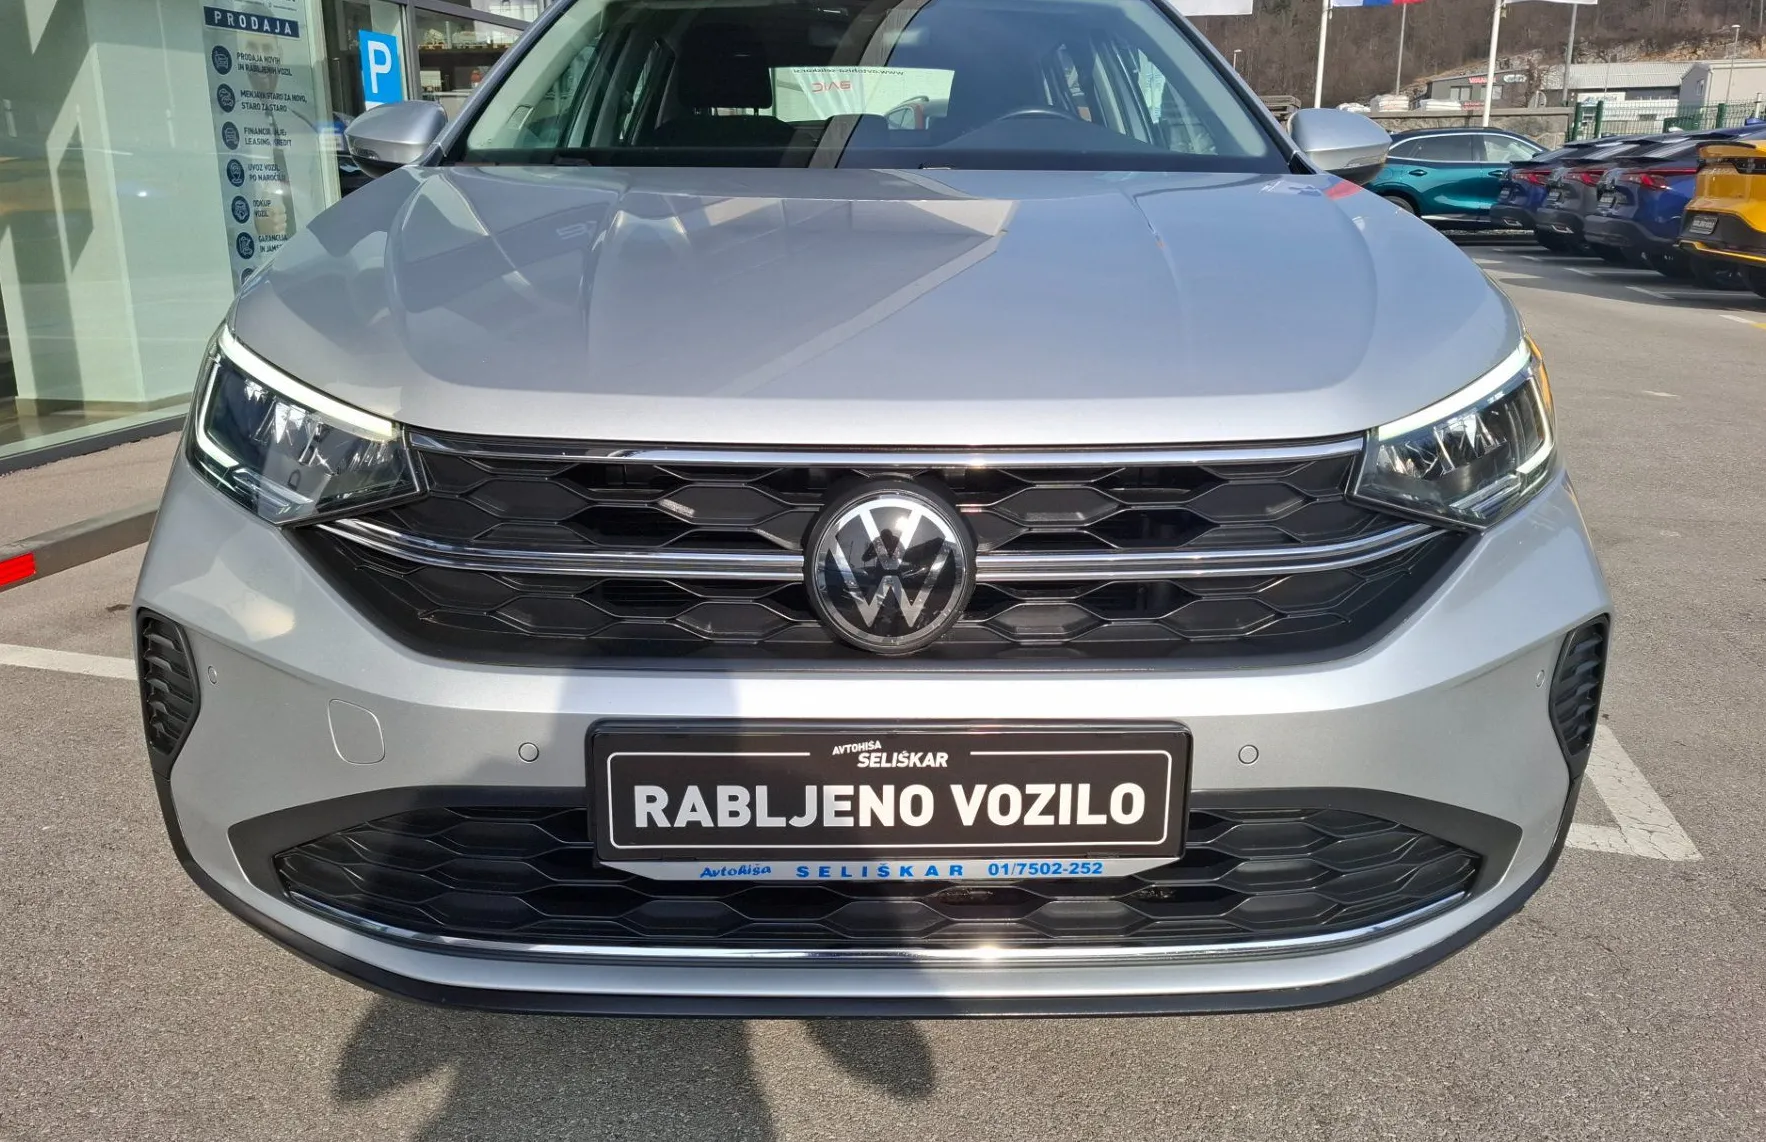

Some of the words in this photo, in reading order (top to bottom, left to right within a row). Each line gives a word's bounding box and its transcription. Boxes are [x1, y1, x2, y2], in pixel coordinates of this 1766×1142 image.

[214, 10, 292, 35] PRODAJA
[237, 52, 263, 63] PRODAJA
[237, 63, 244, 71] IN
[367, 40, 392, 94] P
[284, 93, 291, 101] ZA
[241, 101, 261, 110] STARO
[261, 103, 268, 111] ZA
[268, 104, 287, 112] STARO
[247, 163, 263, 171] UVOZ
[249, 173, 257, 181] PO
[252, 199, 271, 207] ODKUP
[857, 750, 949, 768] SELIŠKAR
[633, 783, 935, 828] RABLJENO
[949, 782, 1146, 827] VOZILO
[700, 864, 771, 878] Avtohiša
[796, 863, 964, 878] SELIŠKAR
[988, 862, 1104, 876] 01/7502-252
